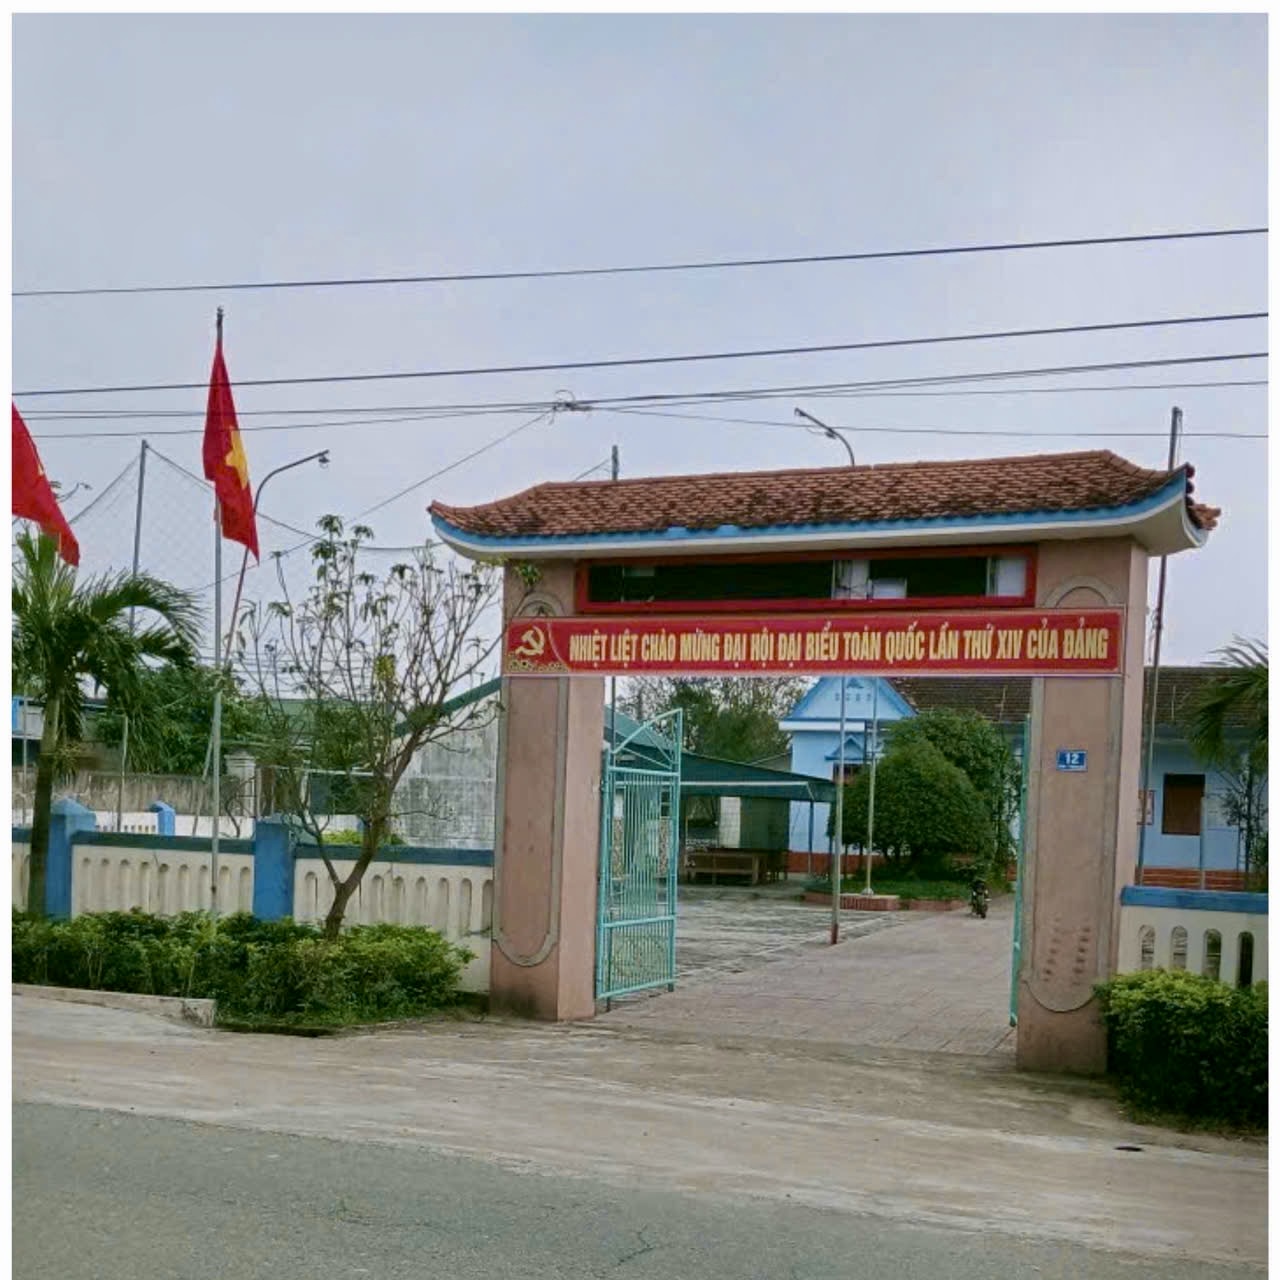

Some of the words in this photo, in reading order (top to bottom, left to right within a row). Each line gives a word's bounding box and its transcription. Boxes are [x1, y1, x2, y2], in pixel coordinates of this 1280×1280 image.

[569, 629, 608, 668] NHIỆT
[610, 629, 638, 668] LIỆT
[641, 628, 676, 661] CHÀO
[679, 628, 720, 661] MỪNG
[723, 633, 747, 668] ĐẠI
[750, 627, 774, 667] HỘI
[778, 633, 802, 667] ĐẠI
[805, 621, 839, 661] BIỂU
[843, 626, 881, 660] TOÀN
[885, 621, 925, 663] QUỐC
[929, 622, 959, 660] LẦN
[963, 624, 994, 659] THỨ
[996, 630, 1023, 659] XIV
[1027, 617, 1058, 659] CỦA
[1063, 617, 1109, 659] ĐẢNG
[1065, 753, 1080, 764] 12
